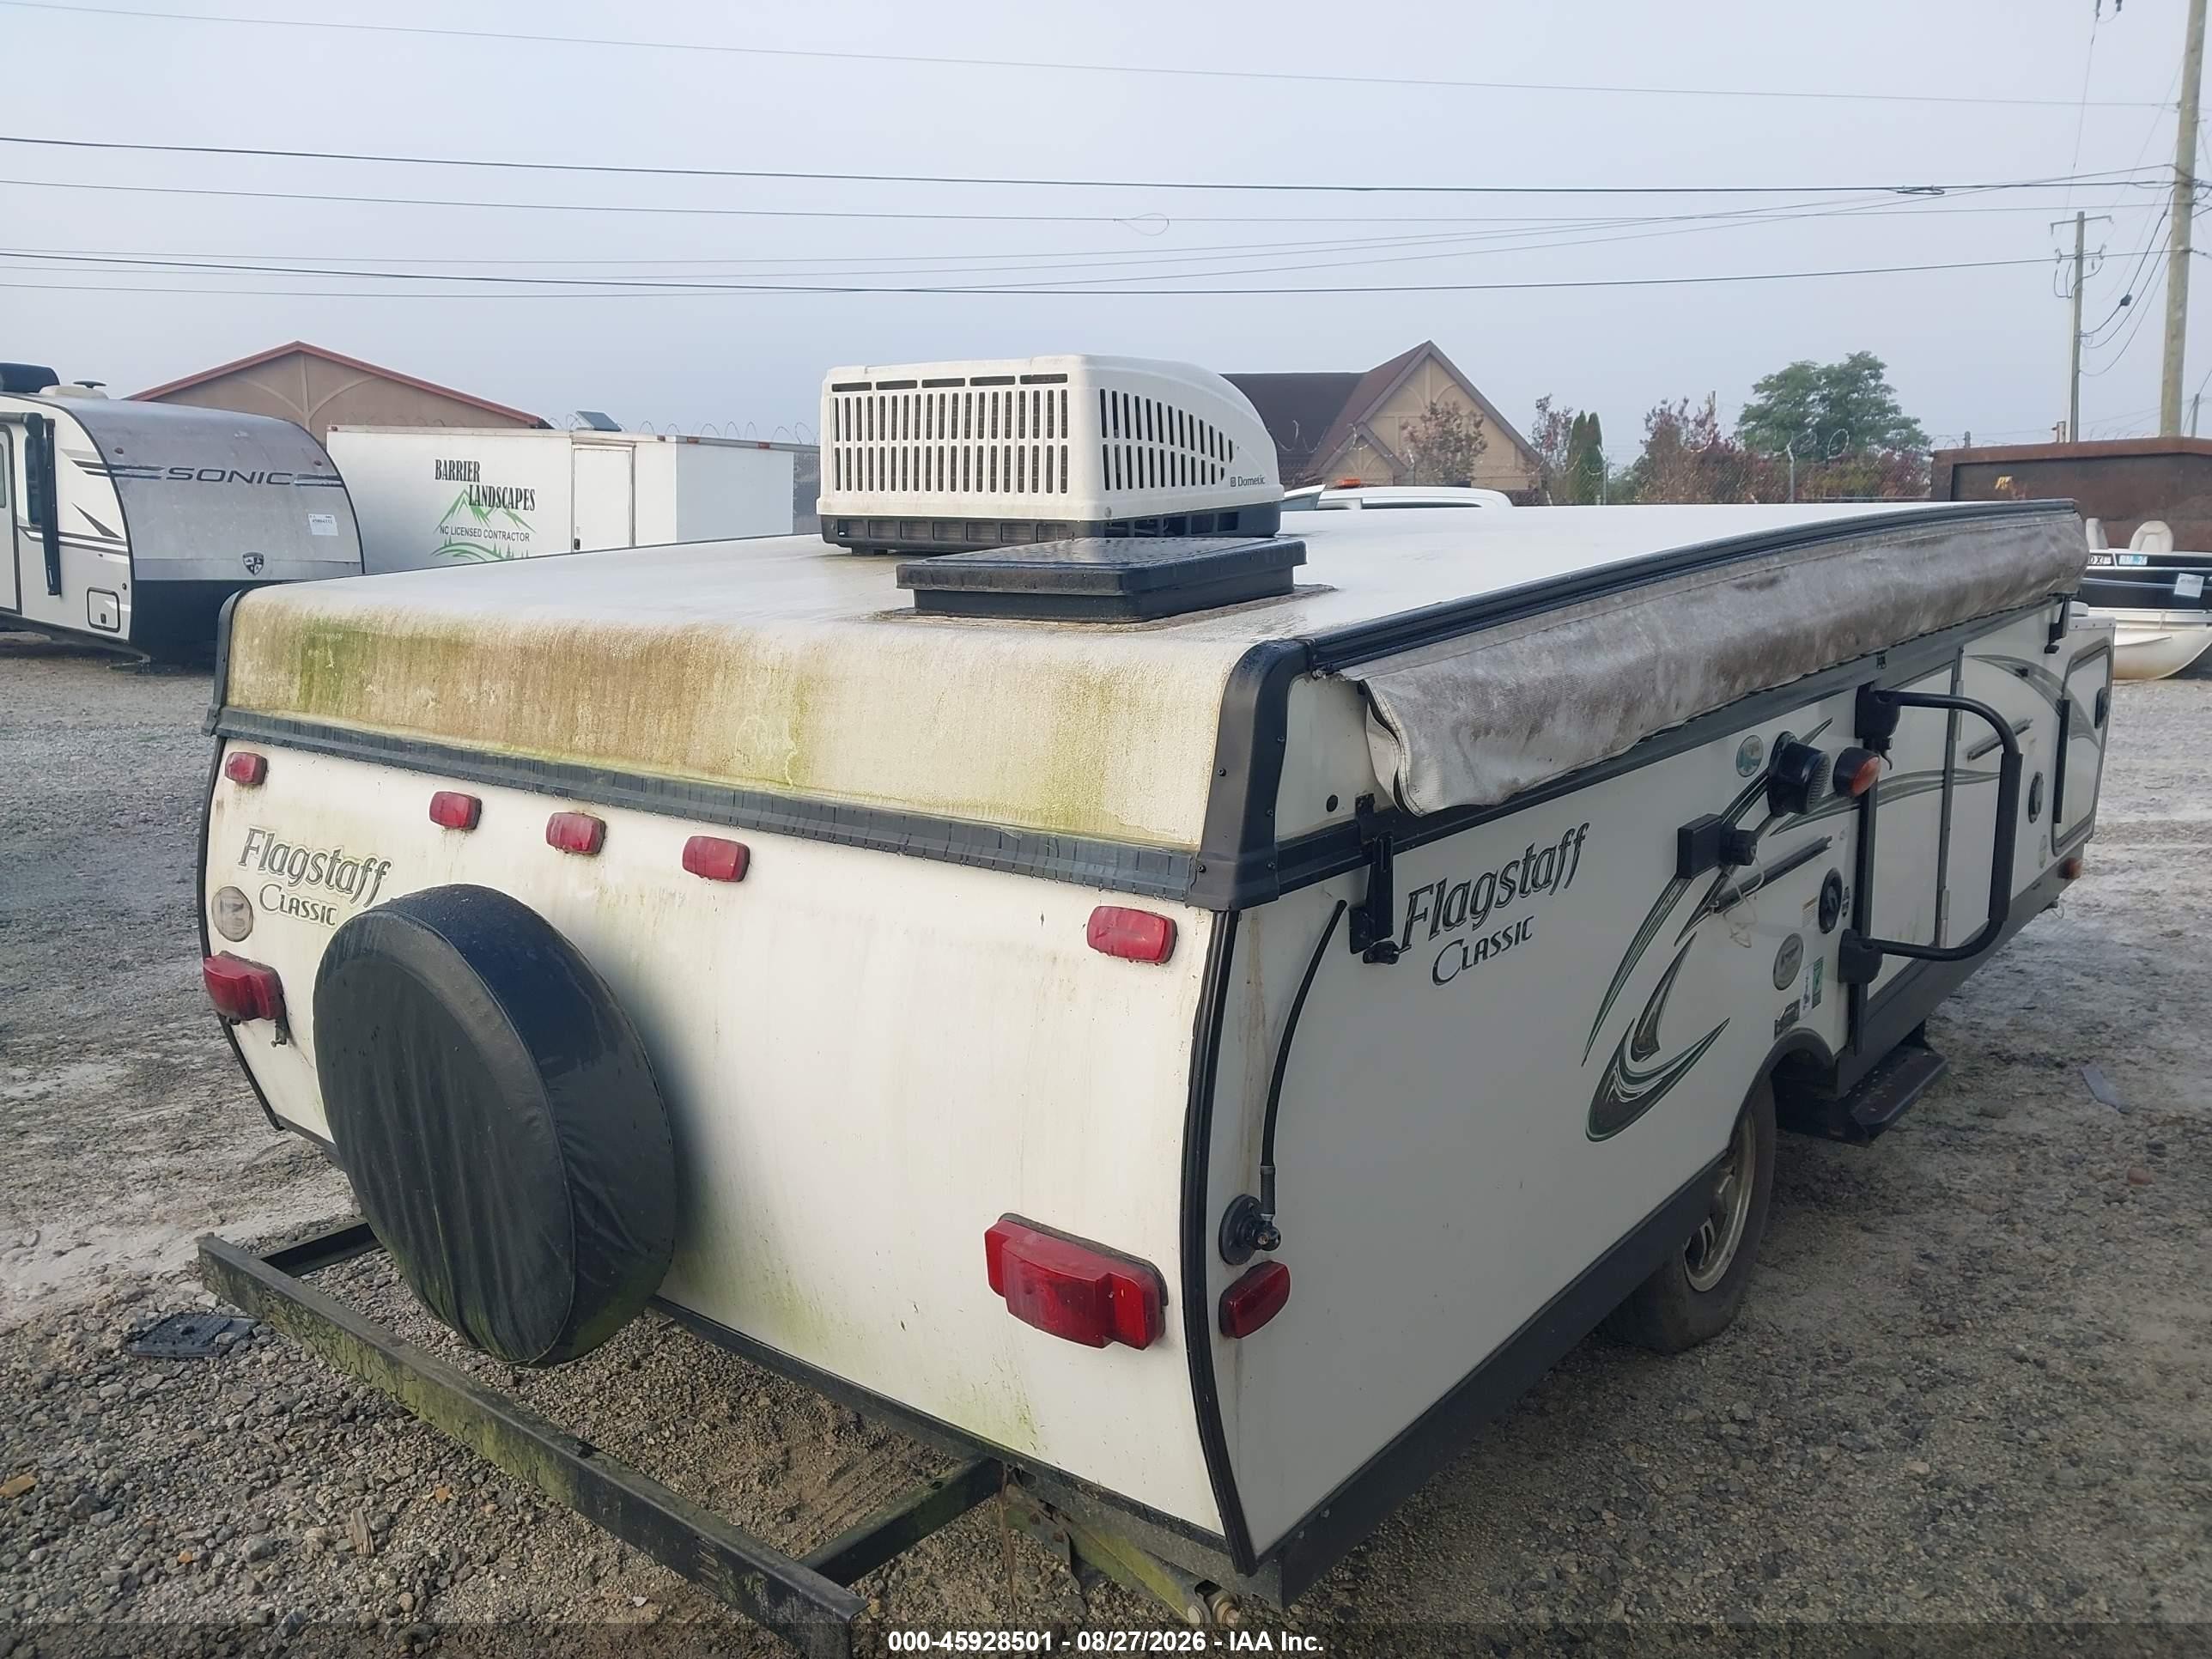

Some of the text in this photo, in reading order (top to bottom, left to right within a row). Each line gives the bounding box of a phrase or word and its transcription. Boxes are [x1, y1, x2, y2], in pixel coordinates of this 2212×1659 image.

[166, 466, 294, 485] SONIC
[434, 459, 481, 483] BARRIER
[1237, 474, 1266, 487] Dometic
[469, 483, 536, 512] LANDSCAPES
[440, 525, 530, 542] NC LICENSED CONTRACTOR
[238, 827, 392, 908] Flagstaff
[1398, 822, 1590, 955] Flagstaff
